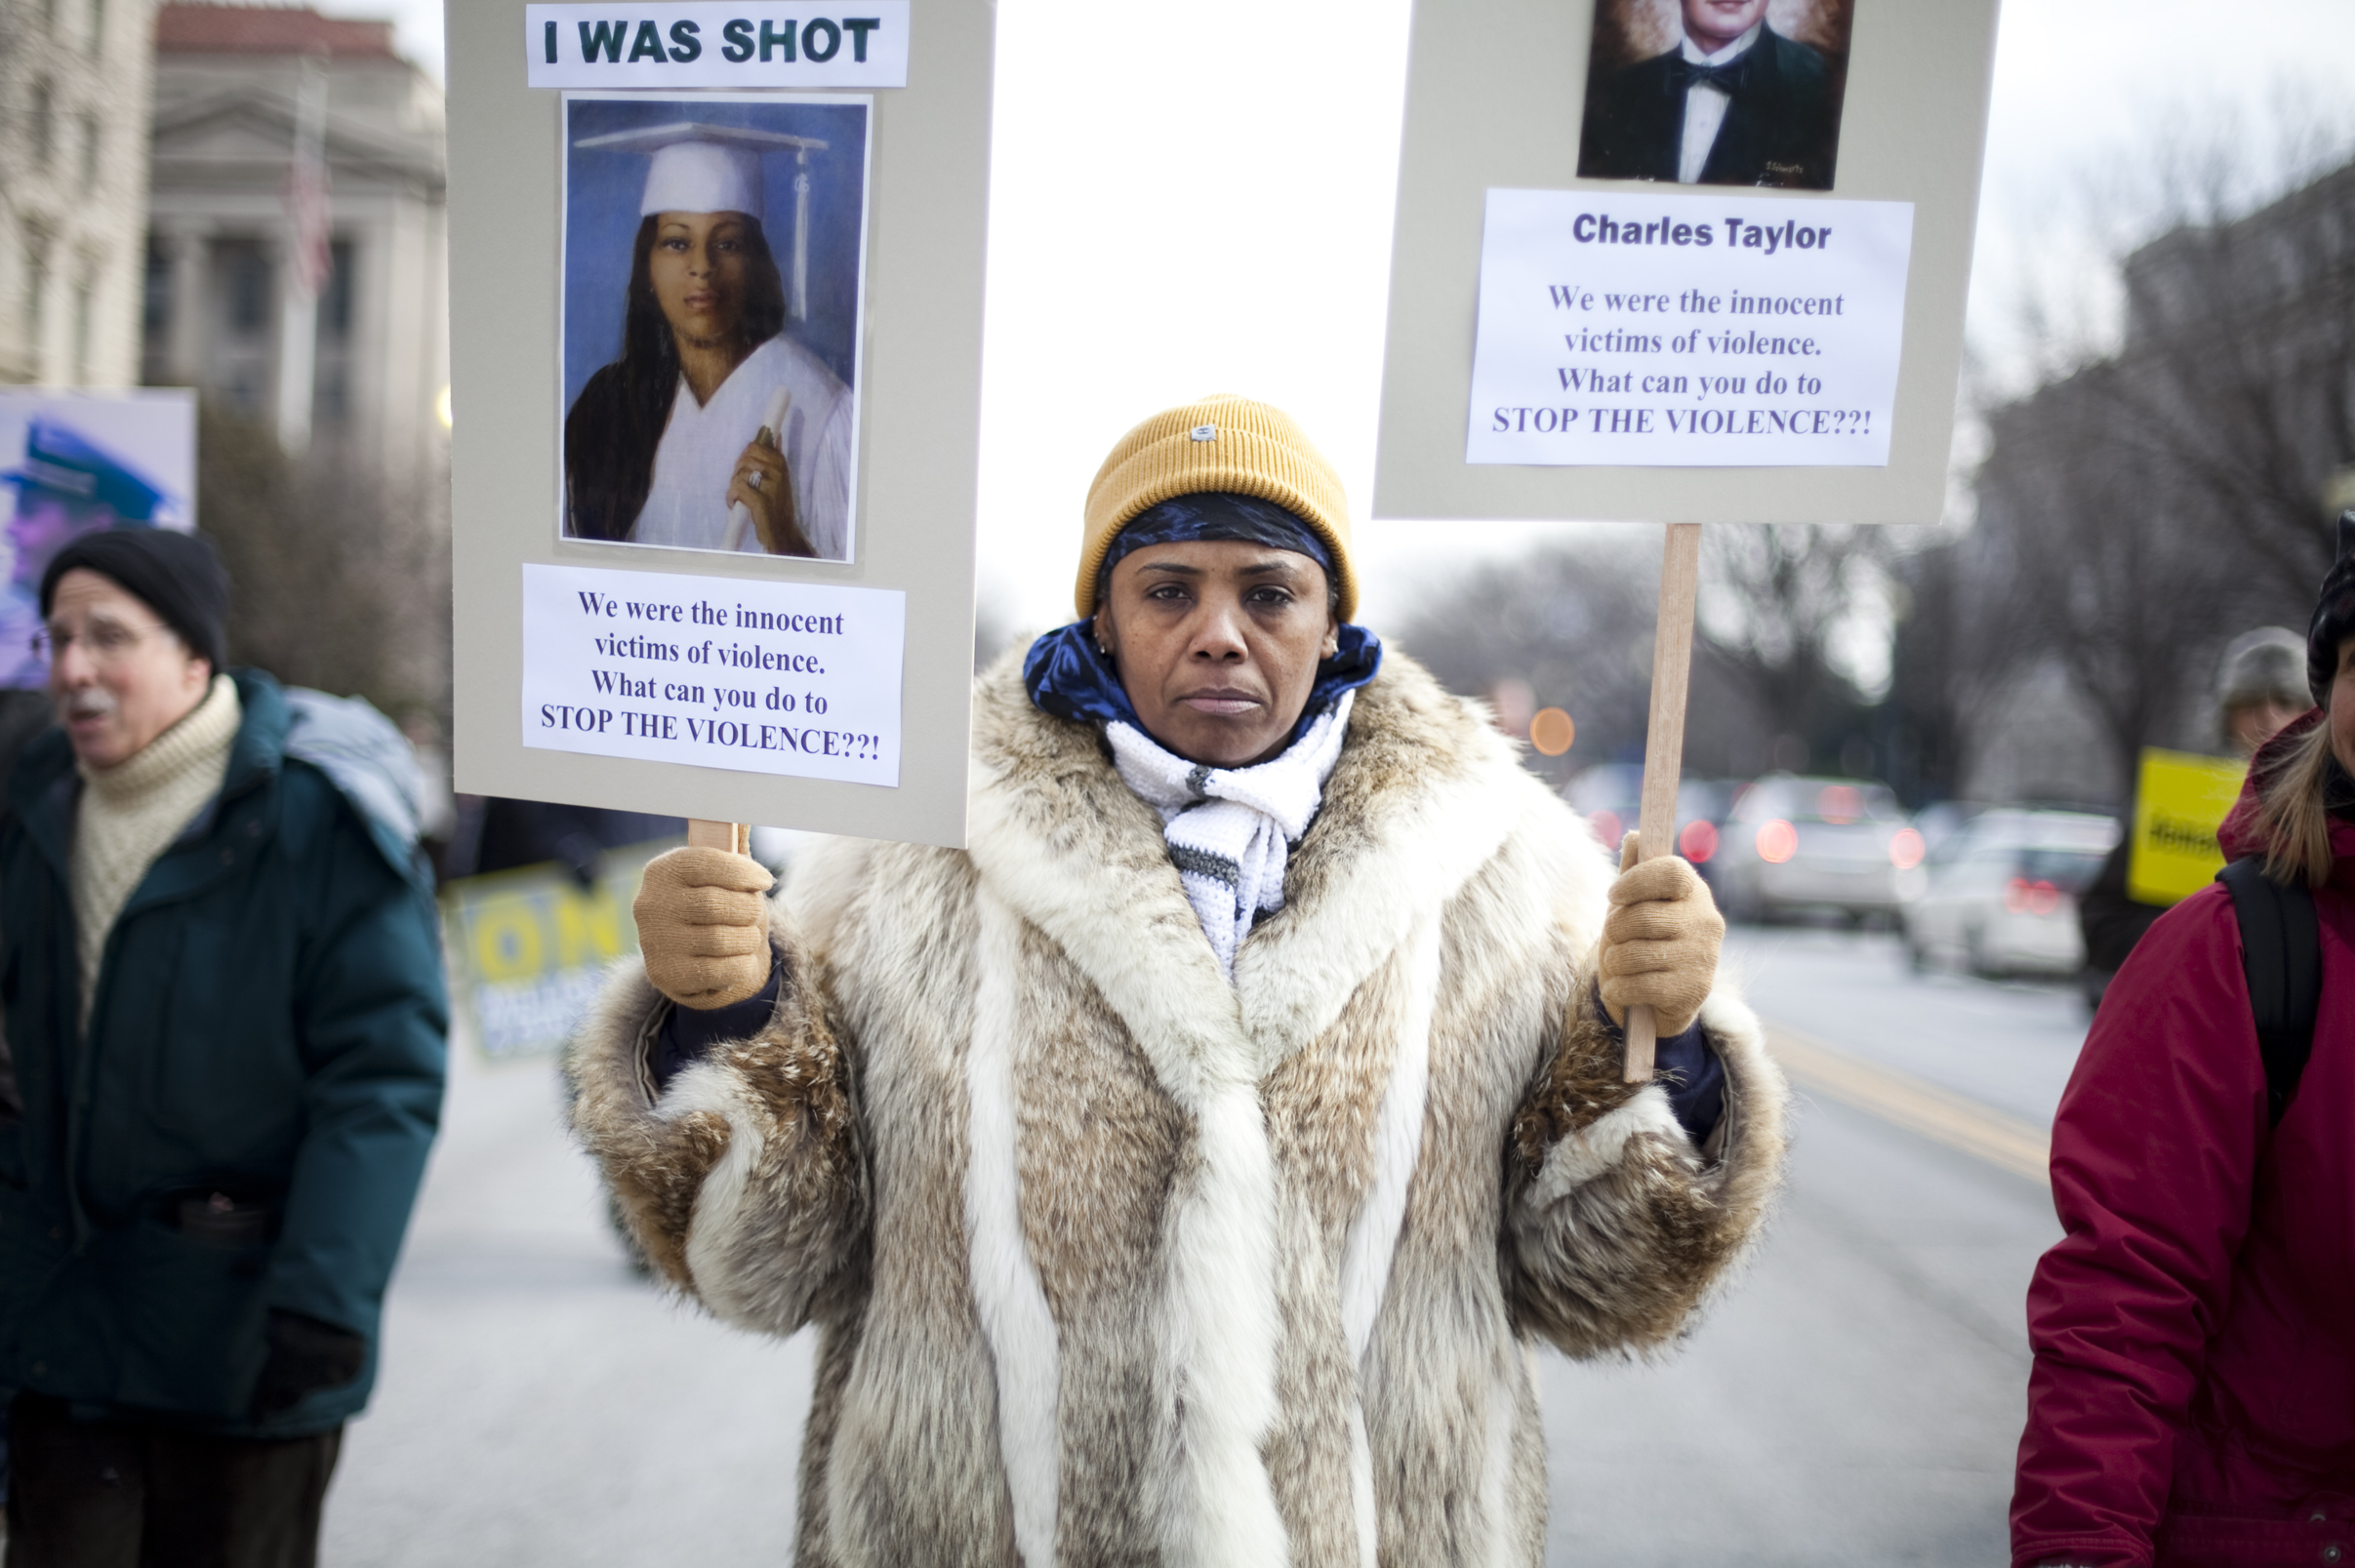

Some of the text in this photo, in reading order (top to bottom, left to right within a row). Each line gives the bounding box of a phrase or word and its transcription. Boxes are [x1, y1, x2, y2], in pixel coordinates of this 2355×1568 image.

[544, 17, 881, 64] I WAS SHOT
[1572, 213, 1833, 256] Charles Taylor
[1548, 284, 1845, 316] We were the innocent
[1564, 327, 1822, 357] victims of violence.
[1558, 367, 1822, 401] What can you do to
[1492, 407, 1872, 435] STOP THE VIOLENCE??!
[578, 590, 845, 635] We were the innocent
[594, 631, 826, 675] victims of violence.
[590, 669, 828, 715] What can you do to
[541, 704, 879, 761] STOP THE VIOLENCE??!
